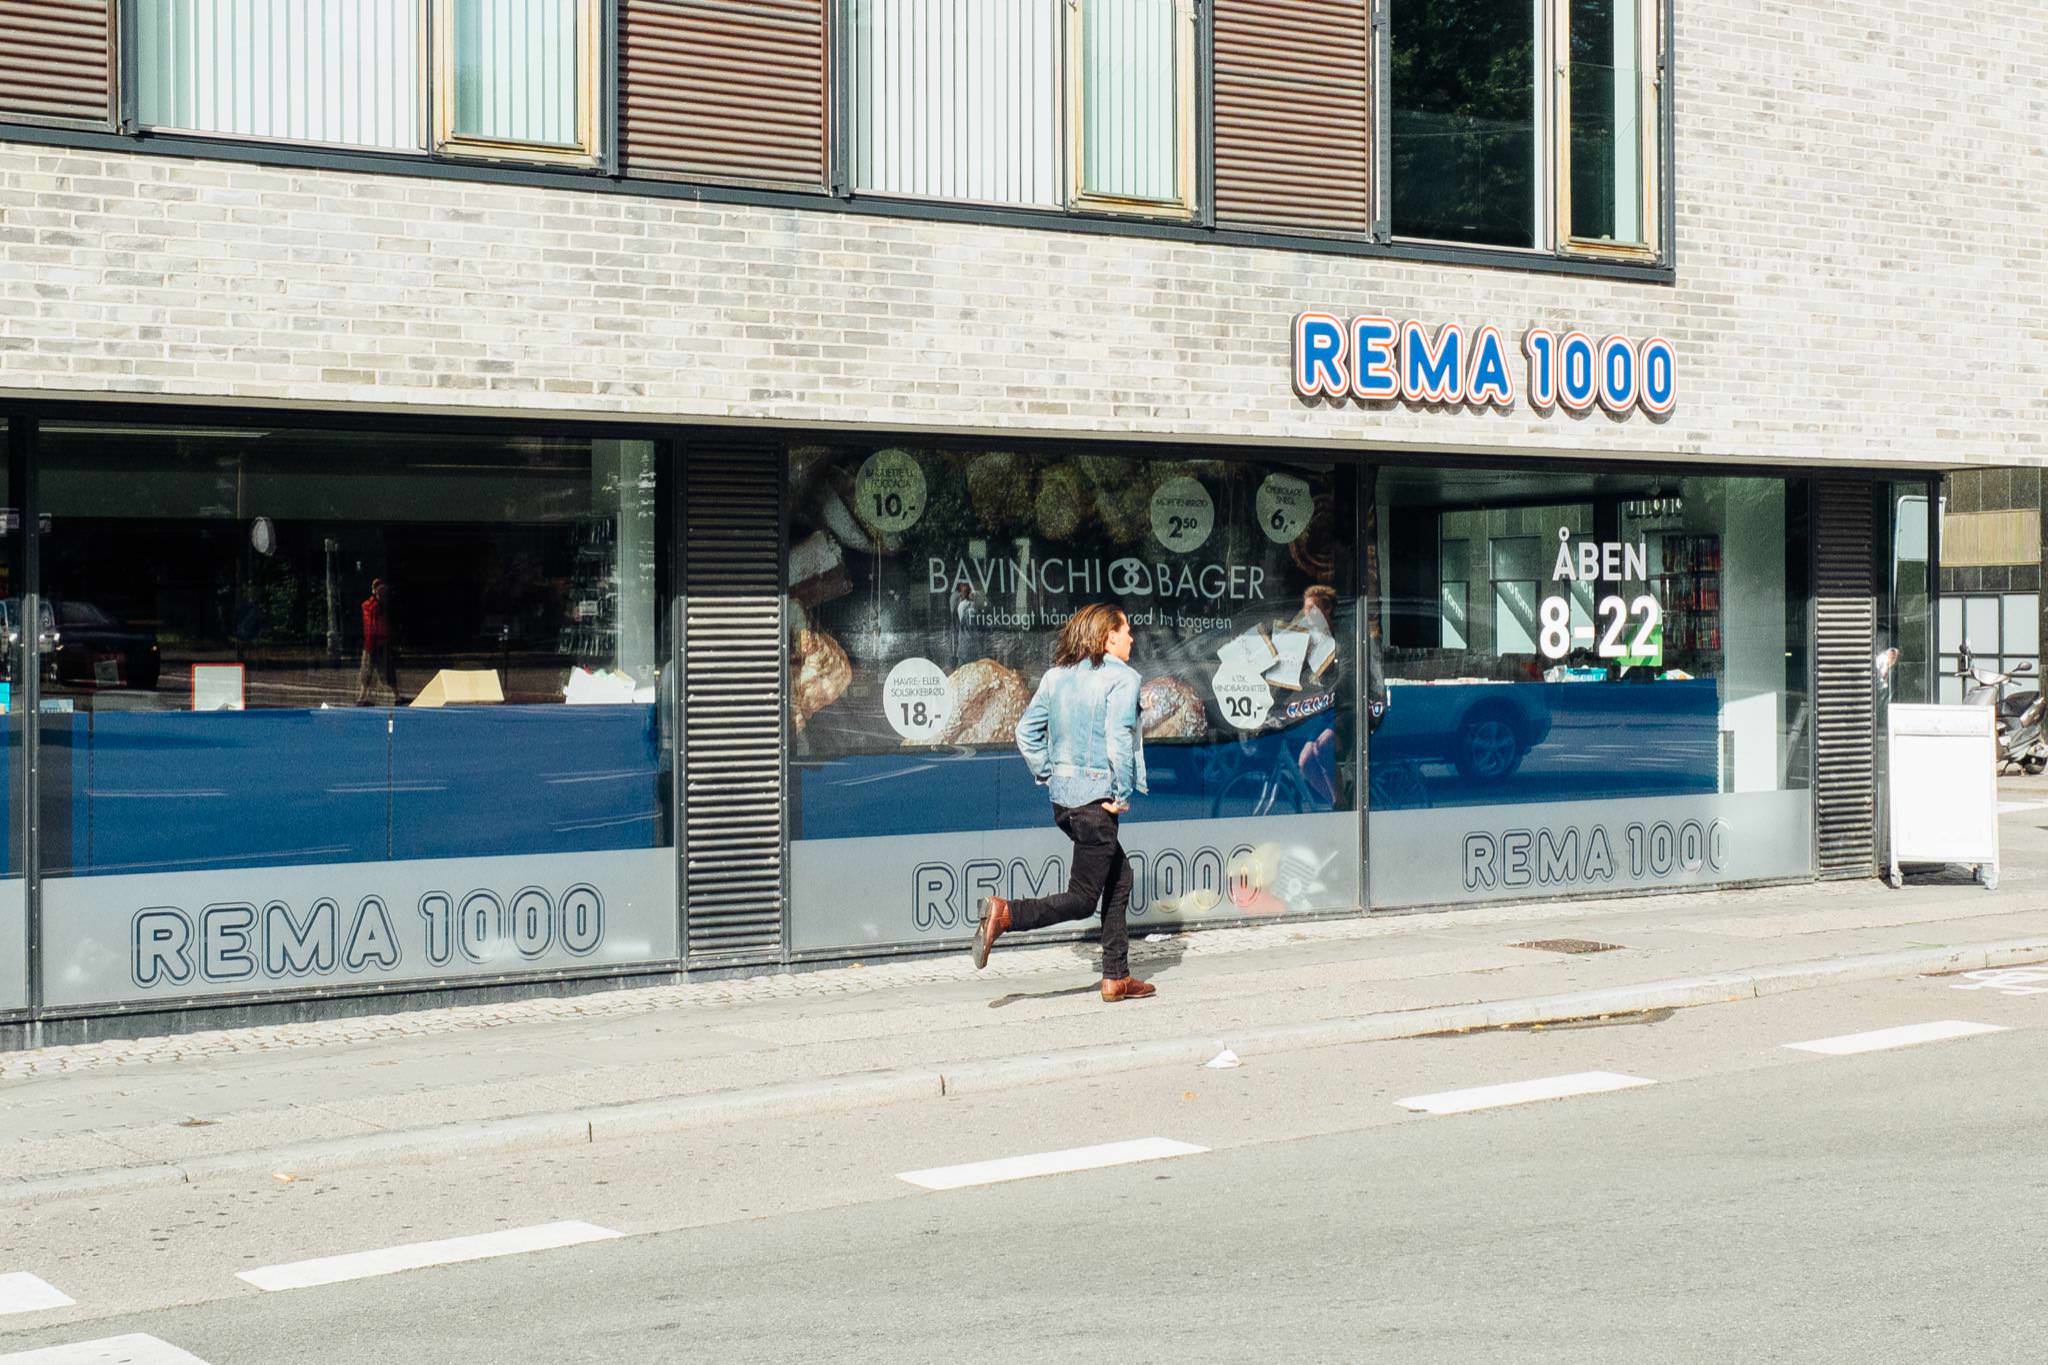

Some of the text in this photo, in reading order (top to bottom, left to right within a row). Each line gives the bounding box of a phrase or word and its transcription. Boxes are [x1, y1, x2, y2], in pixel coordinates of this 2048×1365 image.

[1294, 311, 1678, 416] REMA 1000
[872, 493, 916, 520] 10,-
[1270, 508, 1296, 533] 6,-
[929, 557, 1265, 600] BAVINCHI BAGER
[1552, 527, 1647, 582] ÅBEN
[968, 606, 1036, 631] Friskbagt
[1126, 606, 1153, 626] rød
[1176, 608, 1233, 633] bageren
[1540, 595, 1659, 659] 8-22
[900, 701, 942, 729] 18,-
[1225, 696, 1264, 719] 20,-
[1461, 818, 1735, 893] REMA 1000
[911, 855, 1067, 933] REM
[131, 882, 606, 989] REMA 1000
